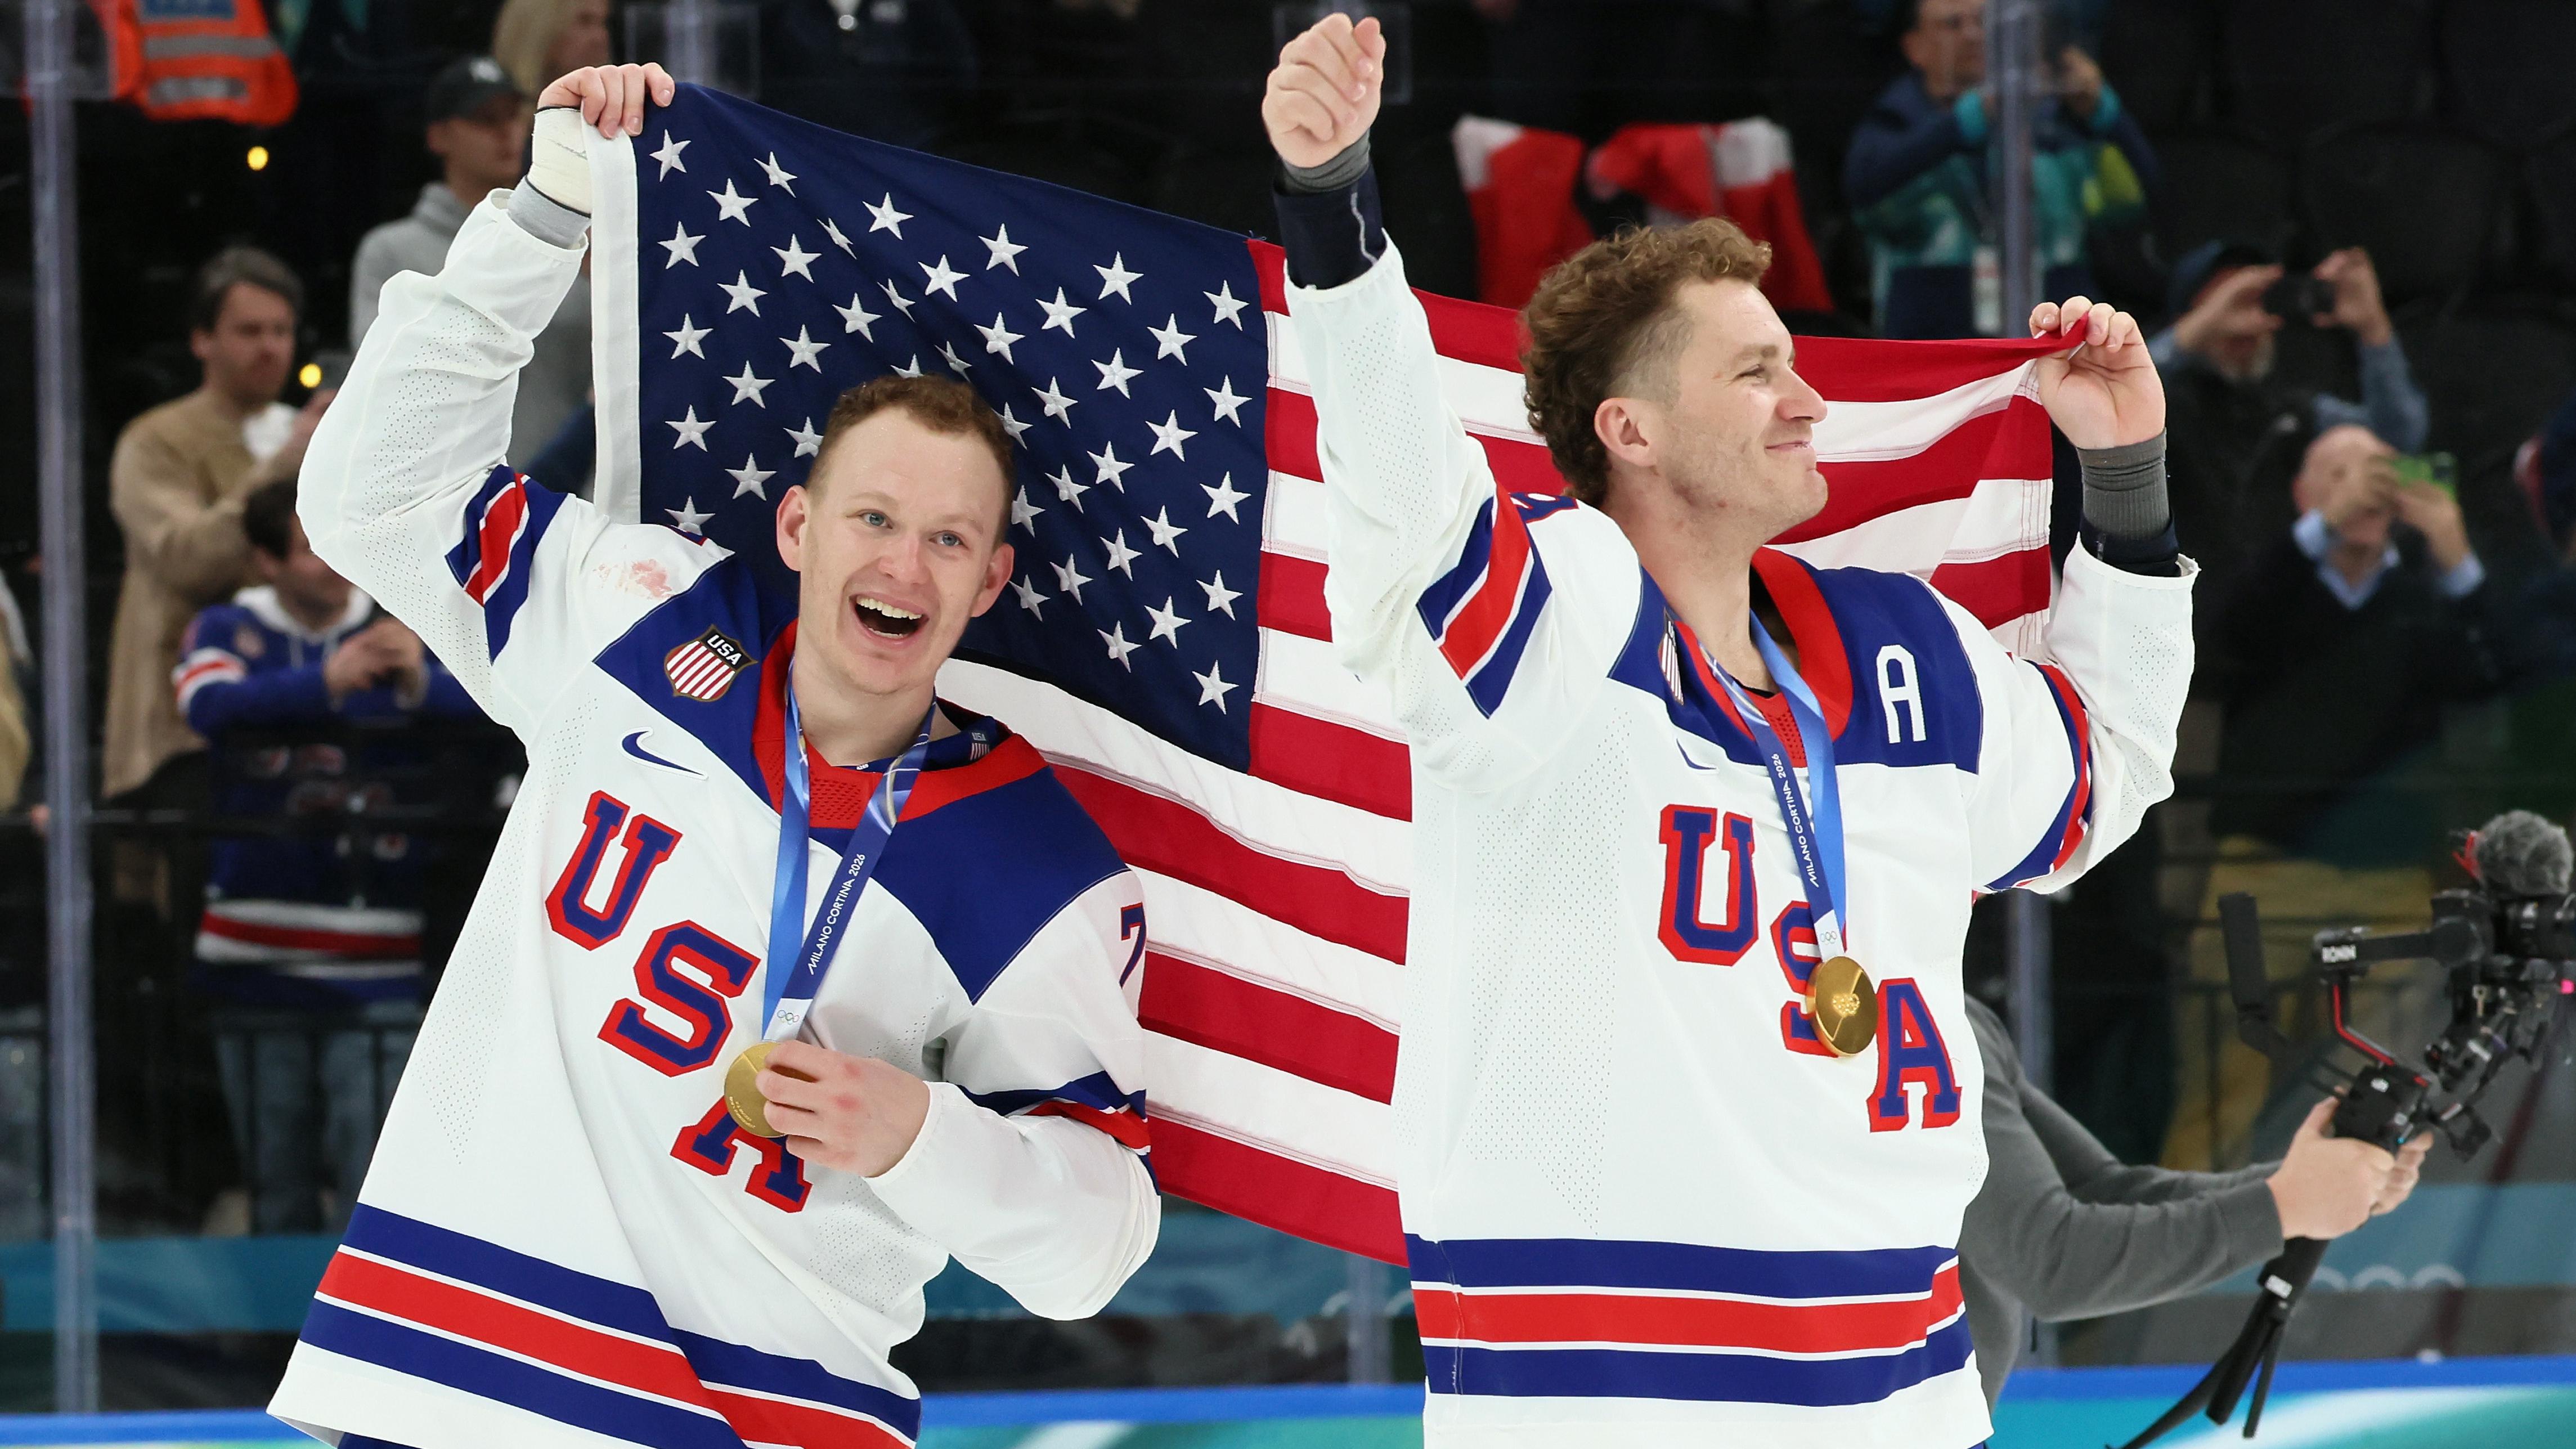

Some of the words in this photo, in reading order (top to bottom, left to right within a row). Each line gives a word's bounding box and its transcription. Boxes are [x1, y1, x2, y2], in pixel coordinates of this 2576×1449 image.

[707, 634, 742, 665] USA
[1876, 644, 1927, 744] A
[1771, 753, 1787, 779] 2026
[1783, 780, 1803, 834] CORTINA
[1799, 835, 1819, 887] MILANO
[807, 925, 832, 975] MILANO
[827, 878, 855, 925] CORTINA
[849, 853, 865, 877] 2026
[1119, 901, 1147, 989] 7
